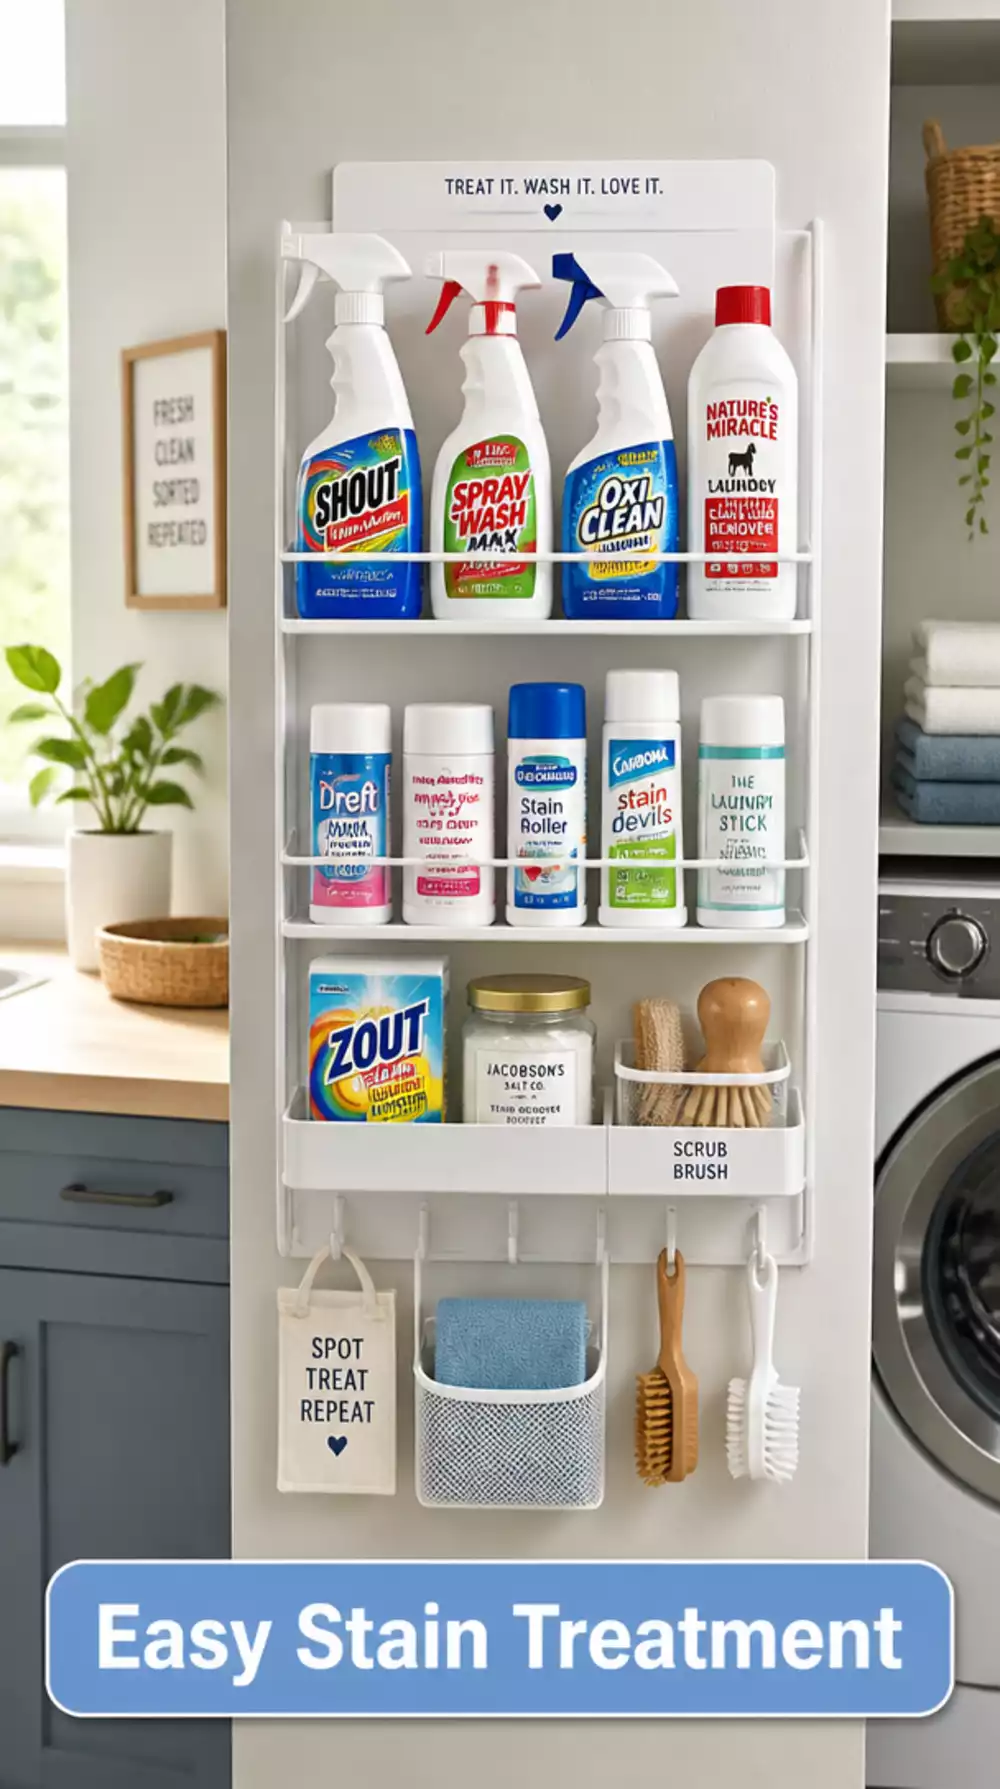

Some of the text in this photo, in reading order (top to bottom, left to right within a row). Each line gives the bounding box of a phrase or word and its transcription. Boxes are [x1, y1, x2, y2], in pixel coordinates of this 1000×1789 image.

[445, 178, 663, 195] TREAT IT. WASH IT. LOVE IT.
[153, 395, 194, 426] FRESH
[706, 397, 779, 421] NATURE'S
[706, 418, 778, 441] MIRACLE
[154, 437, 195, 467] CLEAN
[152, 477, 200, 508] SORTED
[314, 456, 401, 529] SHOUT
[452, 468, 532, 513] SPRAY
[600, 475, 650, 511] OXI
[458, 500, 526, 537] WASH
[580, 496, 664, 545] CLEAN
[147, 519, 208, 549] REPEATED
[319, 779, 378, 815] Dreft
[520, 797, 564, 816] Stain
[617, 782, 667, 811] stain
[520, 818, 568, 835] Roller
[611, 805, 673, 834] devils
[719, 815, 768, 832] STICK
[326, 999, 428, 1083] ZOUT
[486, 1063, 566, 1078] JACOBSON'S
[673, 1140, 728, 1157] SCRUB
[673, 1163, 728, 1180] BRUSH
[311, 1336, 364, 1359] SPOT
[305, 1367, 369, 1391] TREAT
[300, 1399, 376, 1423] REPEAT
